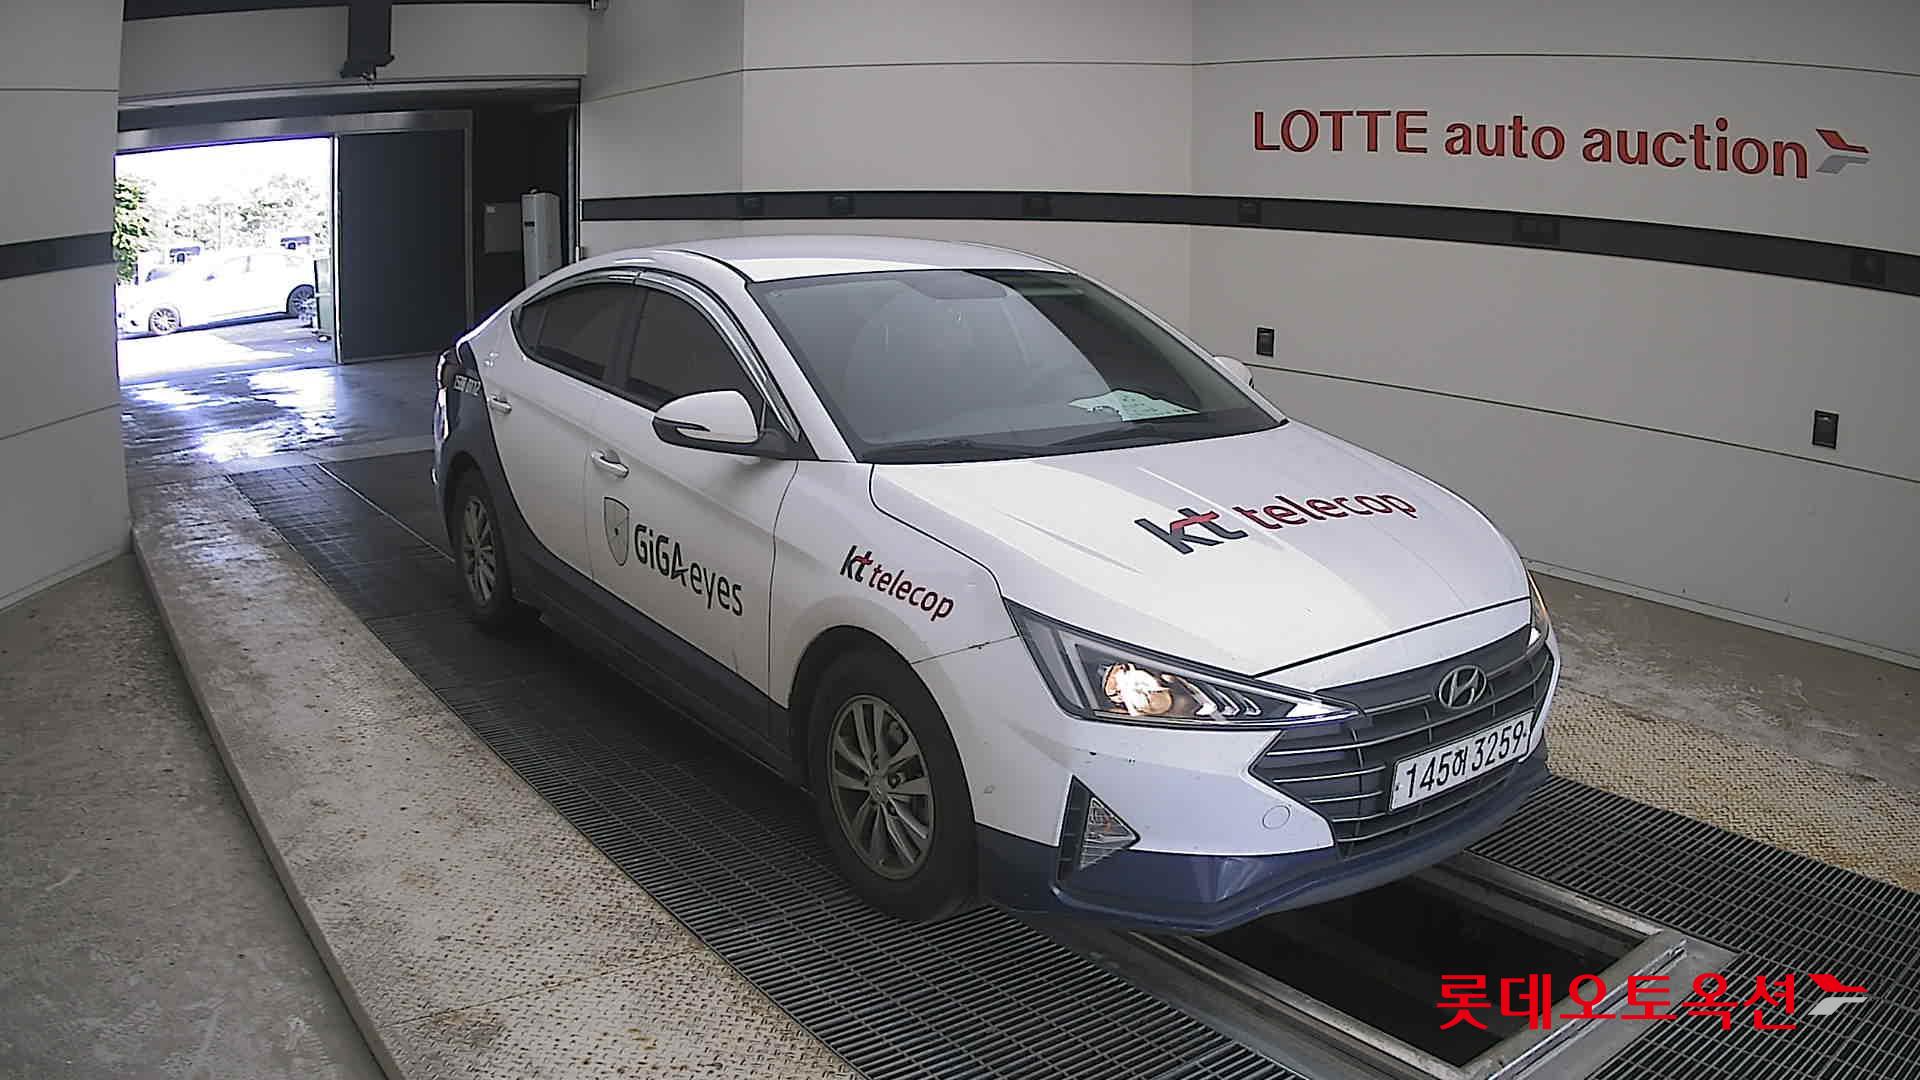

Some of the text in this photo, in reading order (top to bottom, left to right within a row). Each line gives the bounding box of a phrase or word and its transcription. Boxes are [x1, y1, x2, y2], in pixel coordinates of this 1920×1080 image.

[1254, 109, 1808, 179] LOTTE auto auction
[1134, 494, 1418, 555] kt telecop
[840, 545, 954, 621] kt telecop
[1472, 720, 1524, 772] 3259
